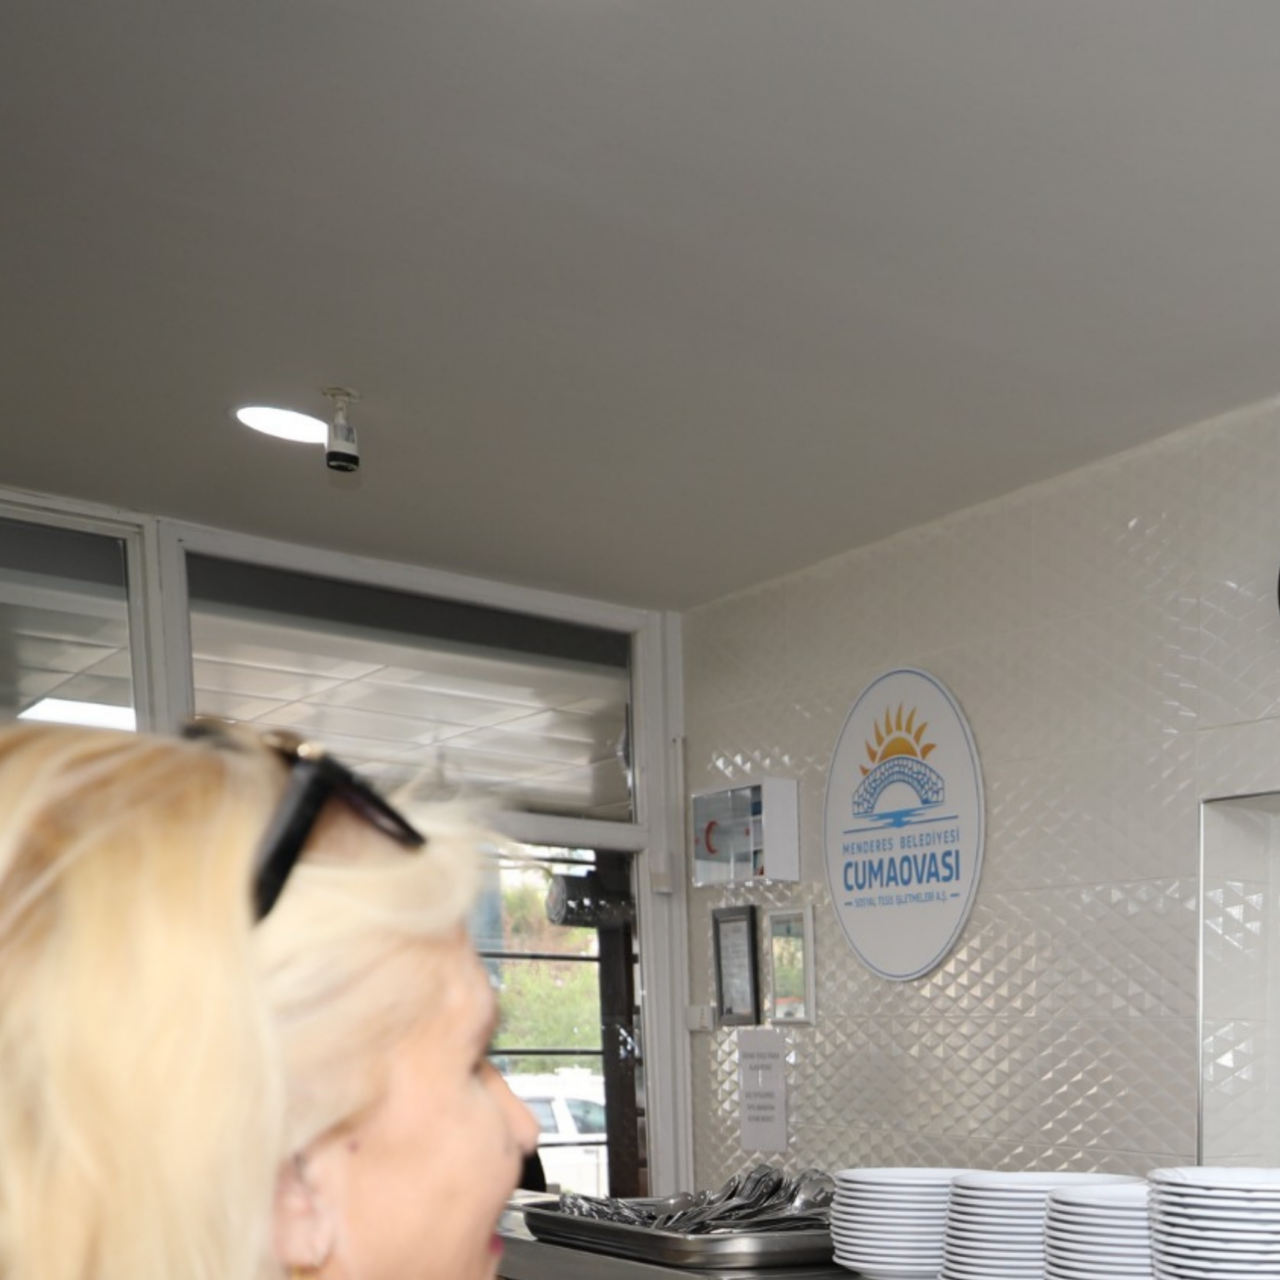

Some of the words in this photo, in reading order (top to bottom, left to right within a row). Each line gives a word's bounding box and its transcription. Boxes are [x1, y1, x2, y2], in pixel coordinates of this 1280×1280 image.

[842, 837, 894, 856] MENDERES
[899, 828, 961, 850] BELEDİYESİ
[843, 849, 961, 892] CUMAOVASI
